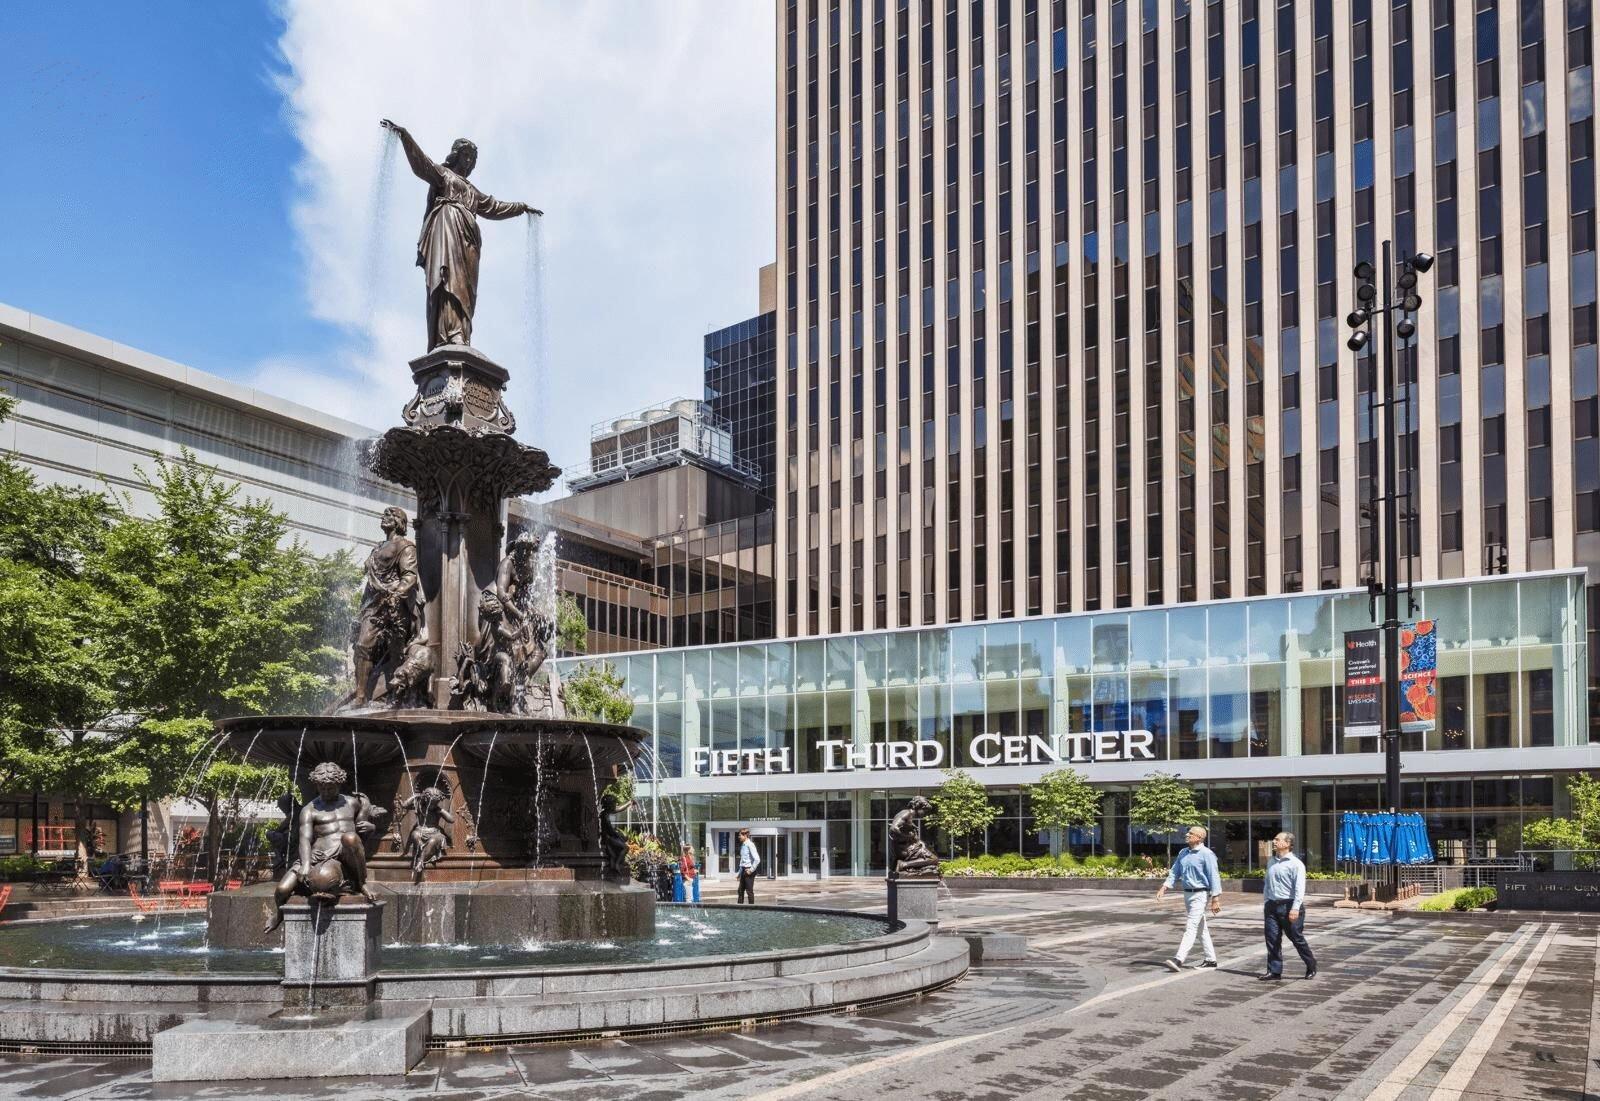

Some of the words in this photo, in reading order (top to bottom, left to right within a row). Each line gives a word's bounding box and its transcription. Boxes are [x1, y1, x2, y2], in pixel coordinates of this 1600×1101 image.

[1356, 640, 1377, 648] Health
[688, 746, 791, 775] FIFTH
[816, 740, 944, 770] THIRD
[969, 729, 1155, 765] CENTER
